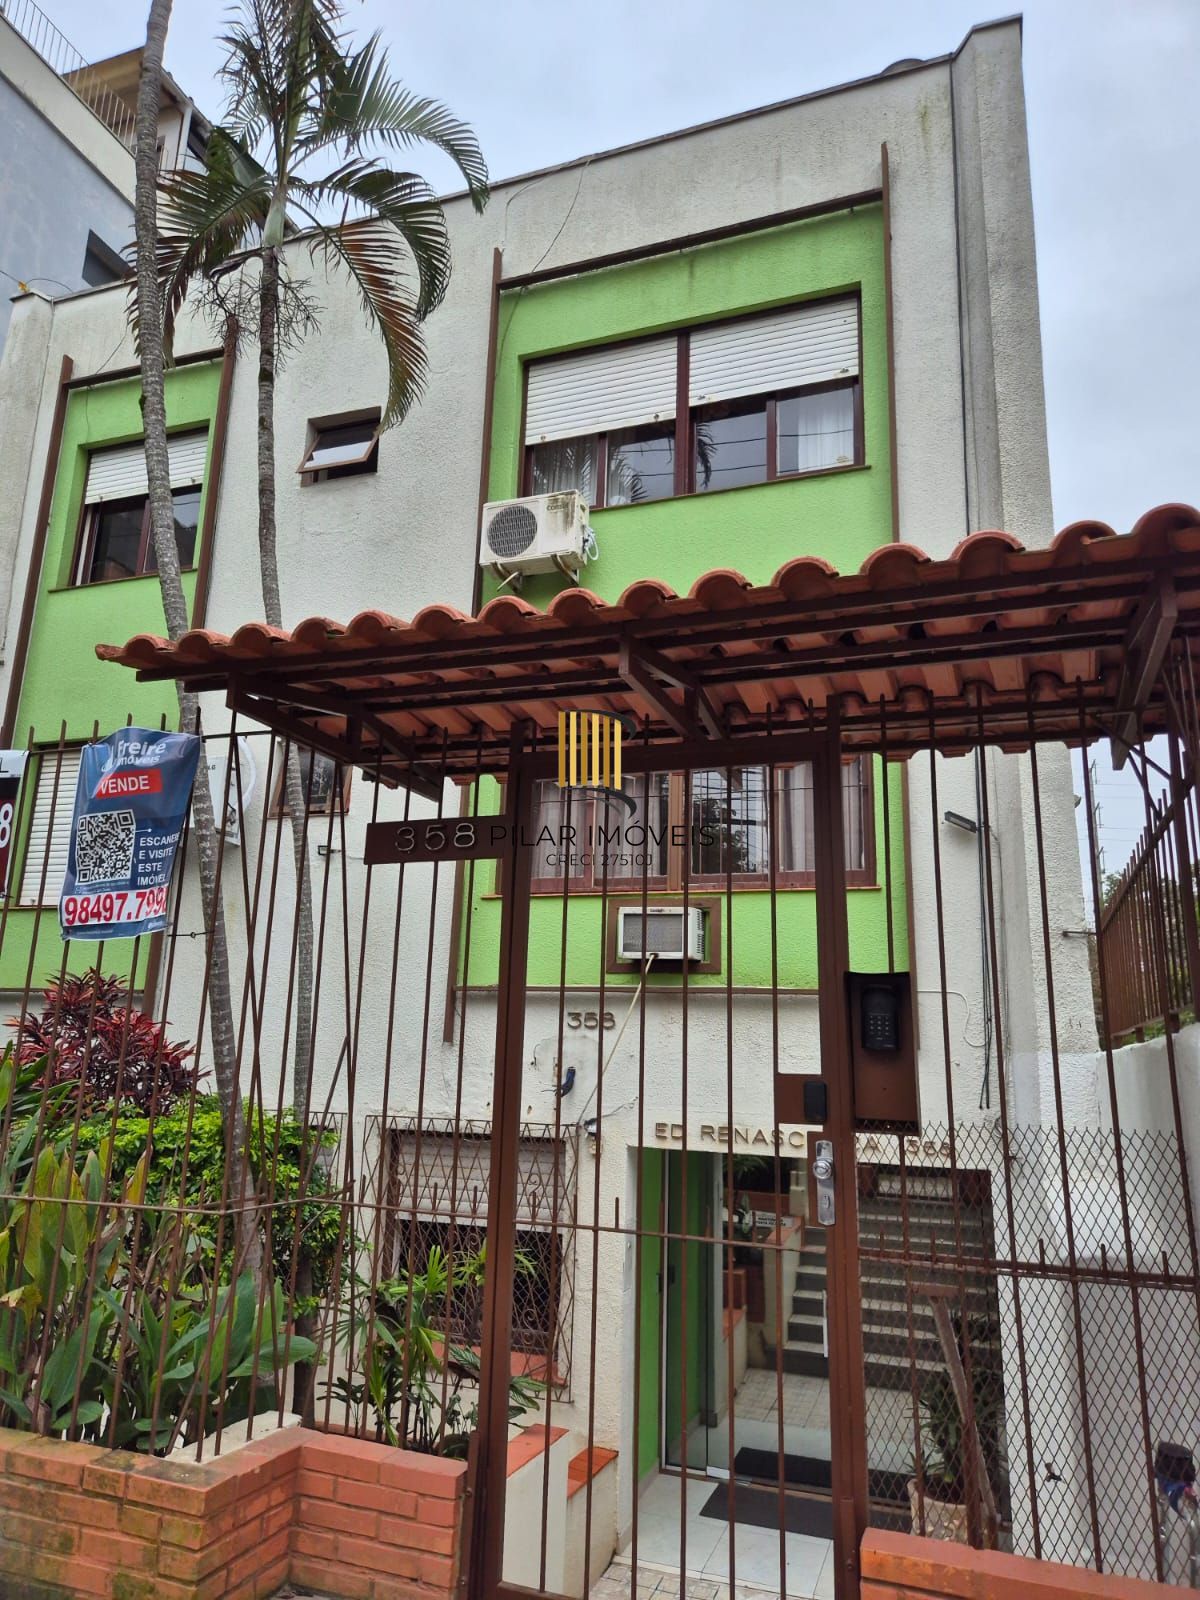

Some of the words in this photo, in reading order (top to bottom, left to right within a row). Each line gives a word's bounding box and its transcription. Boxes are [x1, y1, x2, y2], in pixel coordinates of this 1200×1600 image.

[101, 775, 151, 795] VENDE
[394, 822, 476, 852] 358
[139, 850, 146, 860] E
[149, 846, 173, 859] VISITE
[138, 862, 163, 873] ESTE
[567, 1012, 616, 1030] 358
